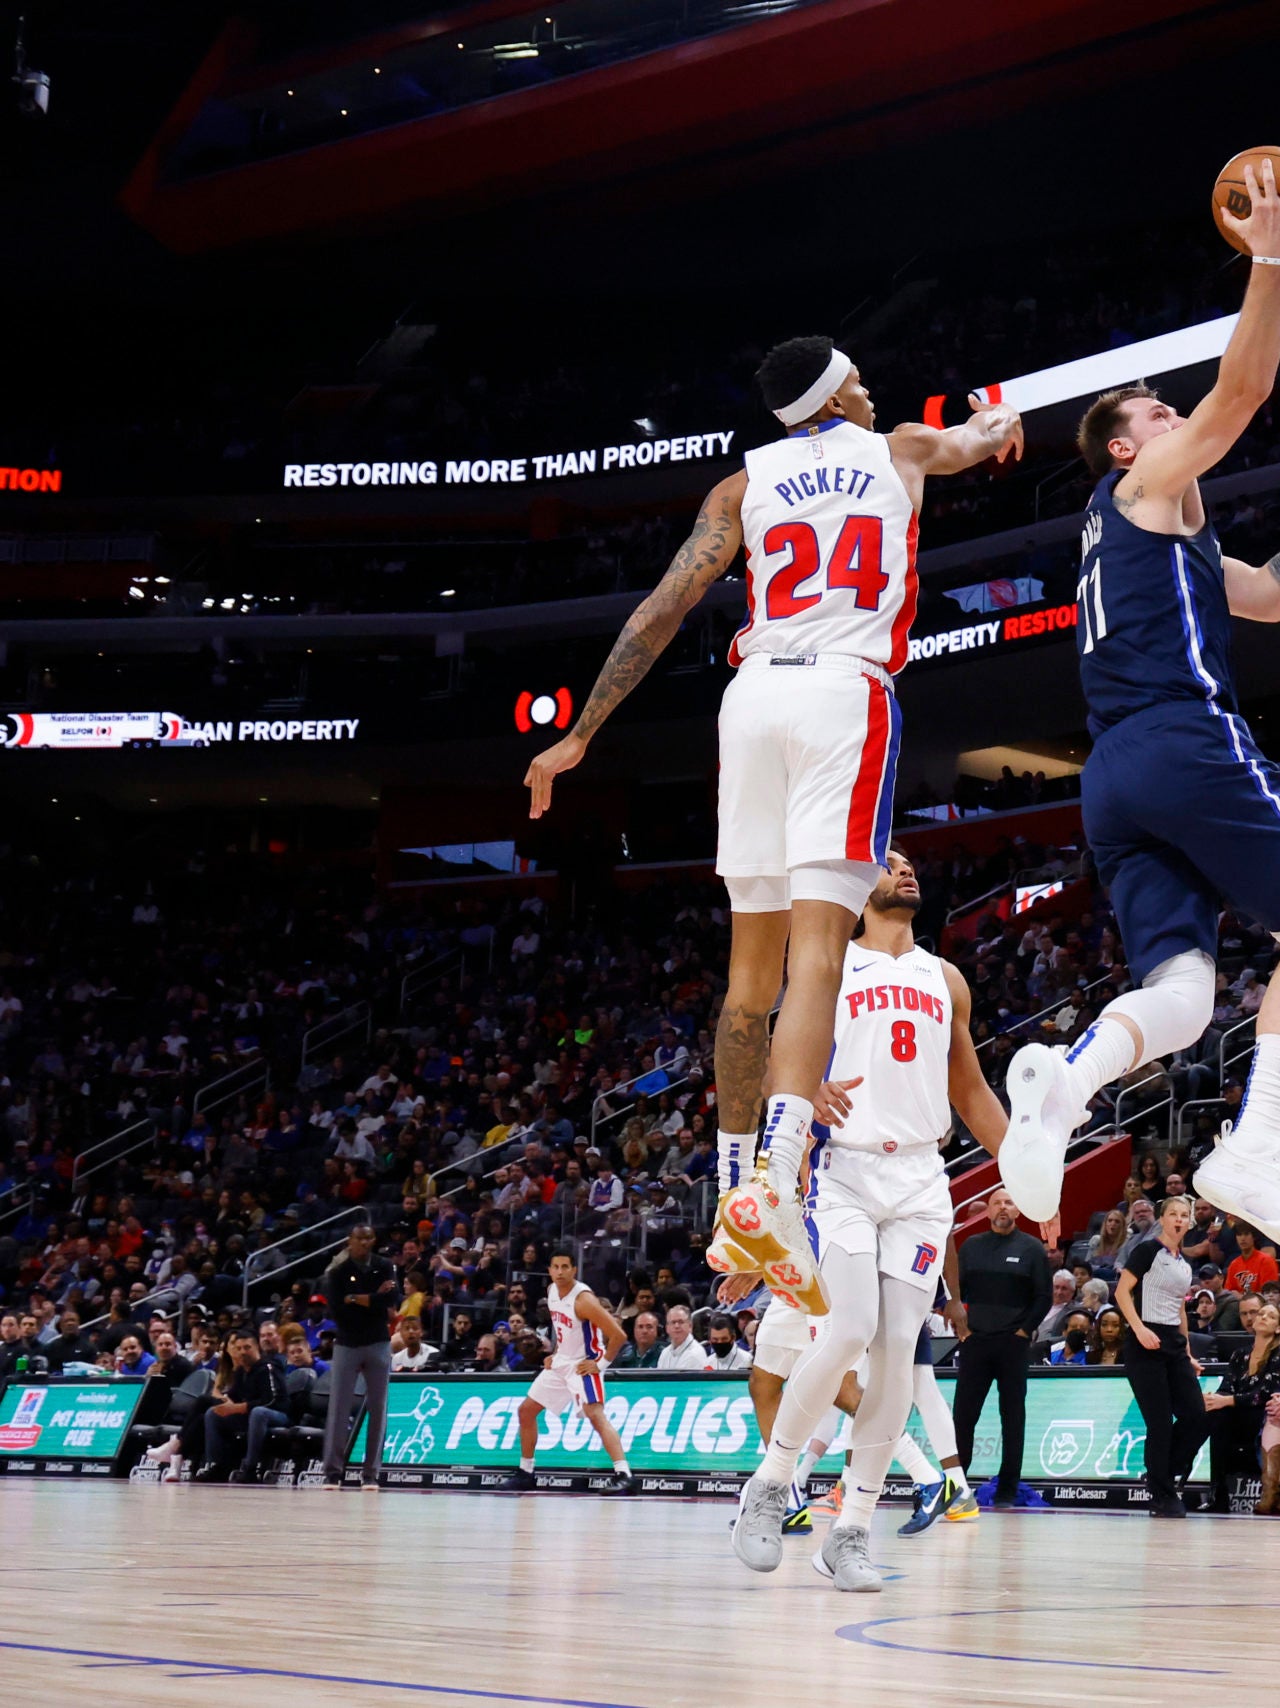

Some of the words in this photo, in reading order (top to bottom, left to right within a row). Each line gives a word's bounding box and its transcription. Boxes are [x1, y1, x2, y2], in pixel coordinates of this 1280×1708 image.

[284, 462, 438, 488] RESTORING
[445, 457, 528, 483] MORE
[531, 450, 597, 479] THAN
[602, 430, 735, 473] PROPERTY
[774, 466, 875, 507] PICKETT
[763, 514, 890, 621] 24
[1076, 556, 1108, 655] 11
[51, 713, 86, 723] National
[88, 713, 125, 722] Disaster
[127, 713, 149, 722] Team
[238, 719, 360, 742] PROPERTY
[845, 984, 945, 1025] PISTONS
[890, 1019, 917, 1063] 8
[49, 1410, 74, 1427] PET
[71, 1410, 126, 1428] SUPPLIES
[445, 1396, 522, 1450] PET
[307, 1458, 324, 1473] Litt
[130, 1466, 160, 1482] Caesars
[298, 1471, 327, 1489] Caesar
[387, 1472, 401, 1482] Little
[401, 1473, 423, 1483] Caesars
[432, 1473, 449, 1485] Little
[448, 1474, 469, 1485] Caesars
[549, 1477, 572, 1488] Caesars
[588, 1477, 605, 1489] Little
[642, 1479, 659, 1490] Little
[658, 1479, 684, 1491] Caesars
[697, 1480, 715, 1492] Little
[714, 1481, 741, 1493] Caesars
[811, 1482, 830, 1495] Little
[889, 1484, 914, 1496] Caesar
[1235, 1478, 1262, 1498] Litt
[1054, 1486, 1076, 1500] Little
[1076, 1487, 1107, 1500] Caesars
[1128, 1488, 1150, 1502] Little
